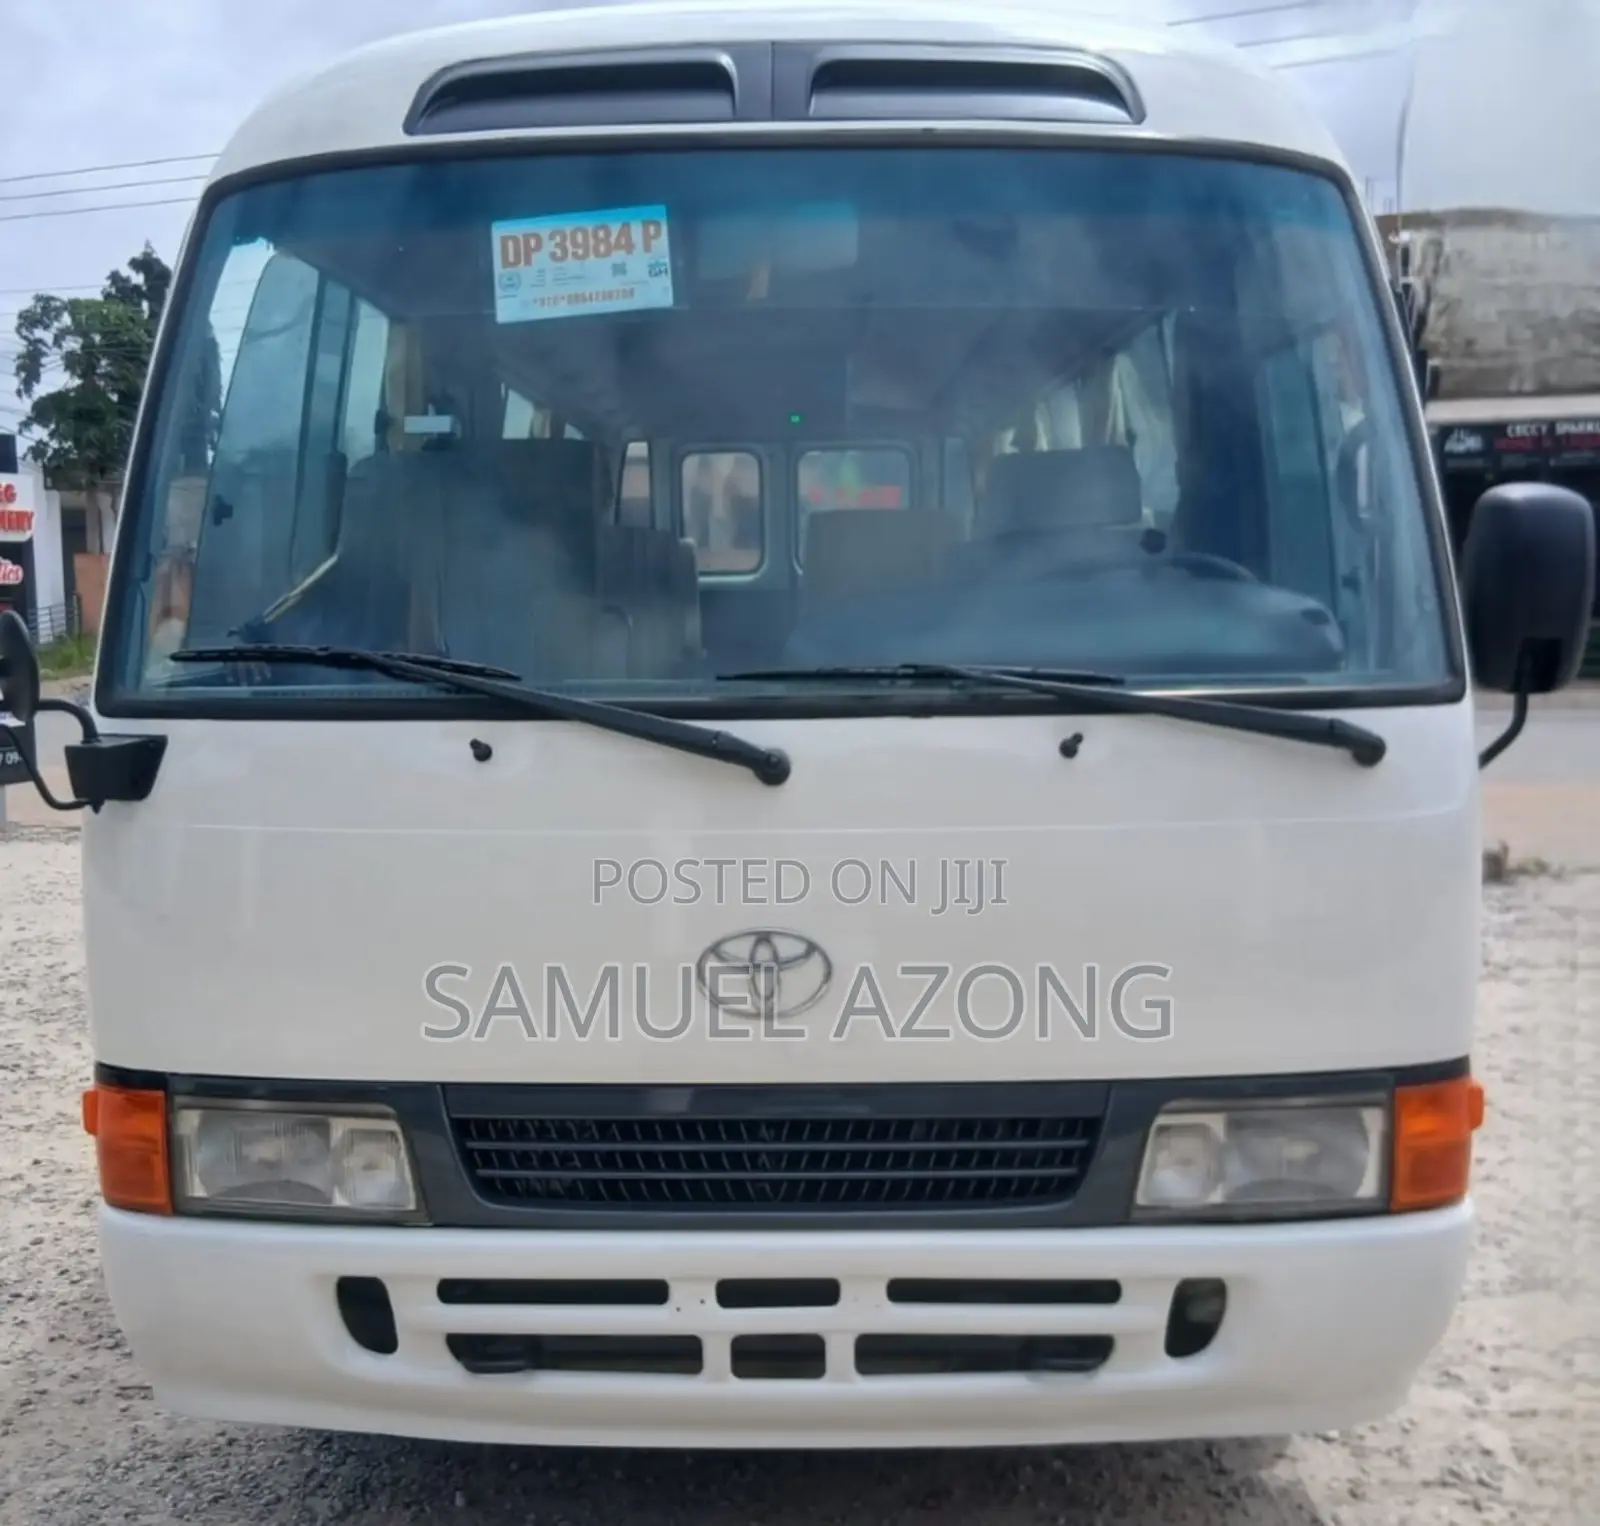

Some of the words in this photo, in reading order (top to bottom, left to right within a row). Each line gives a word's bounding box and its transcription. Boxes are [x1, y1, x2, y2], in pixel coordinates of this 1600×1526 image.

[500, 232, 543, 269] DP
[547, 221, 636, 263] 3984
[641, 219, 662, 254] P
